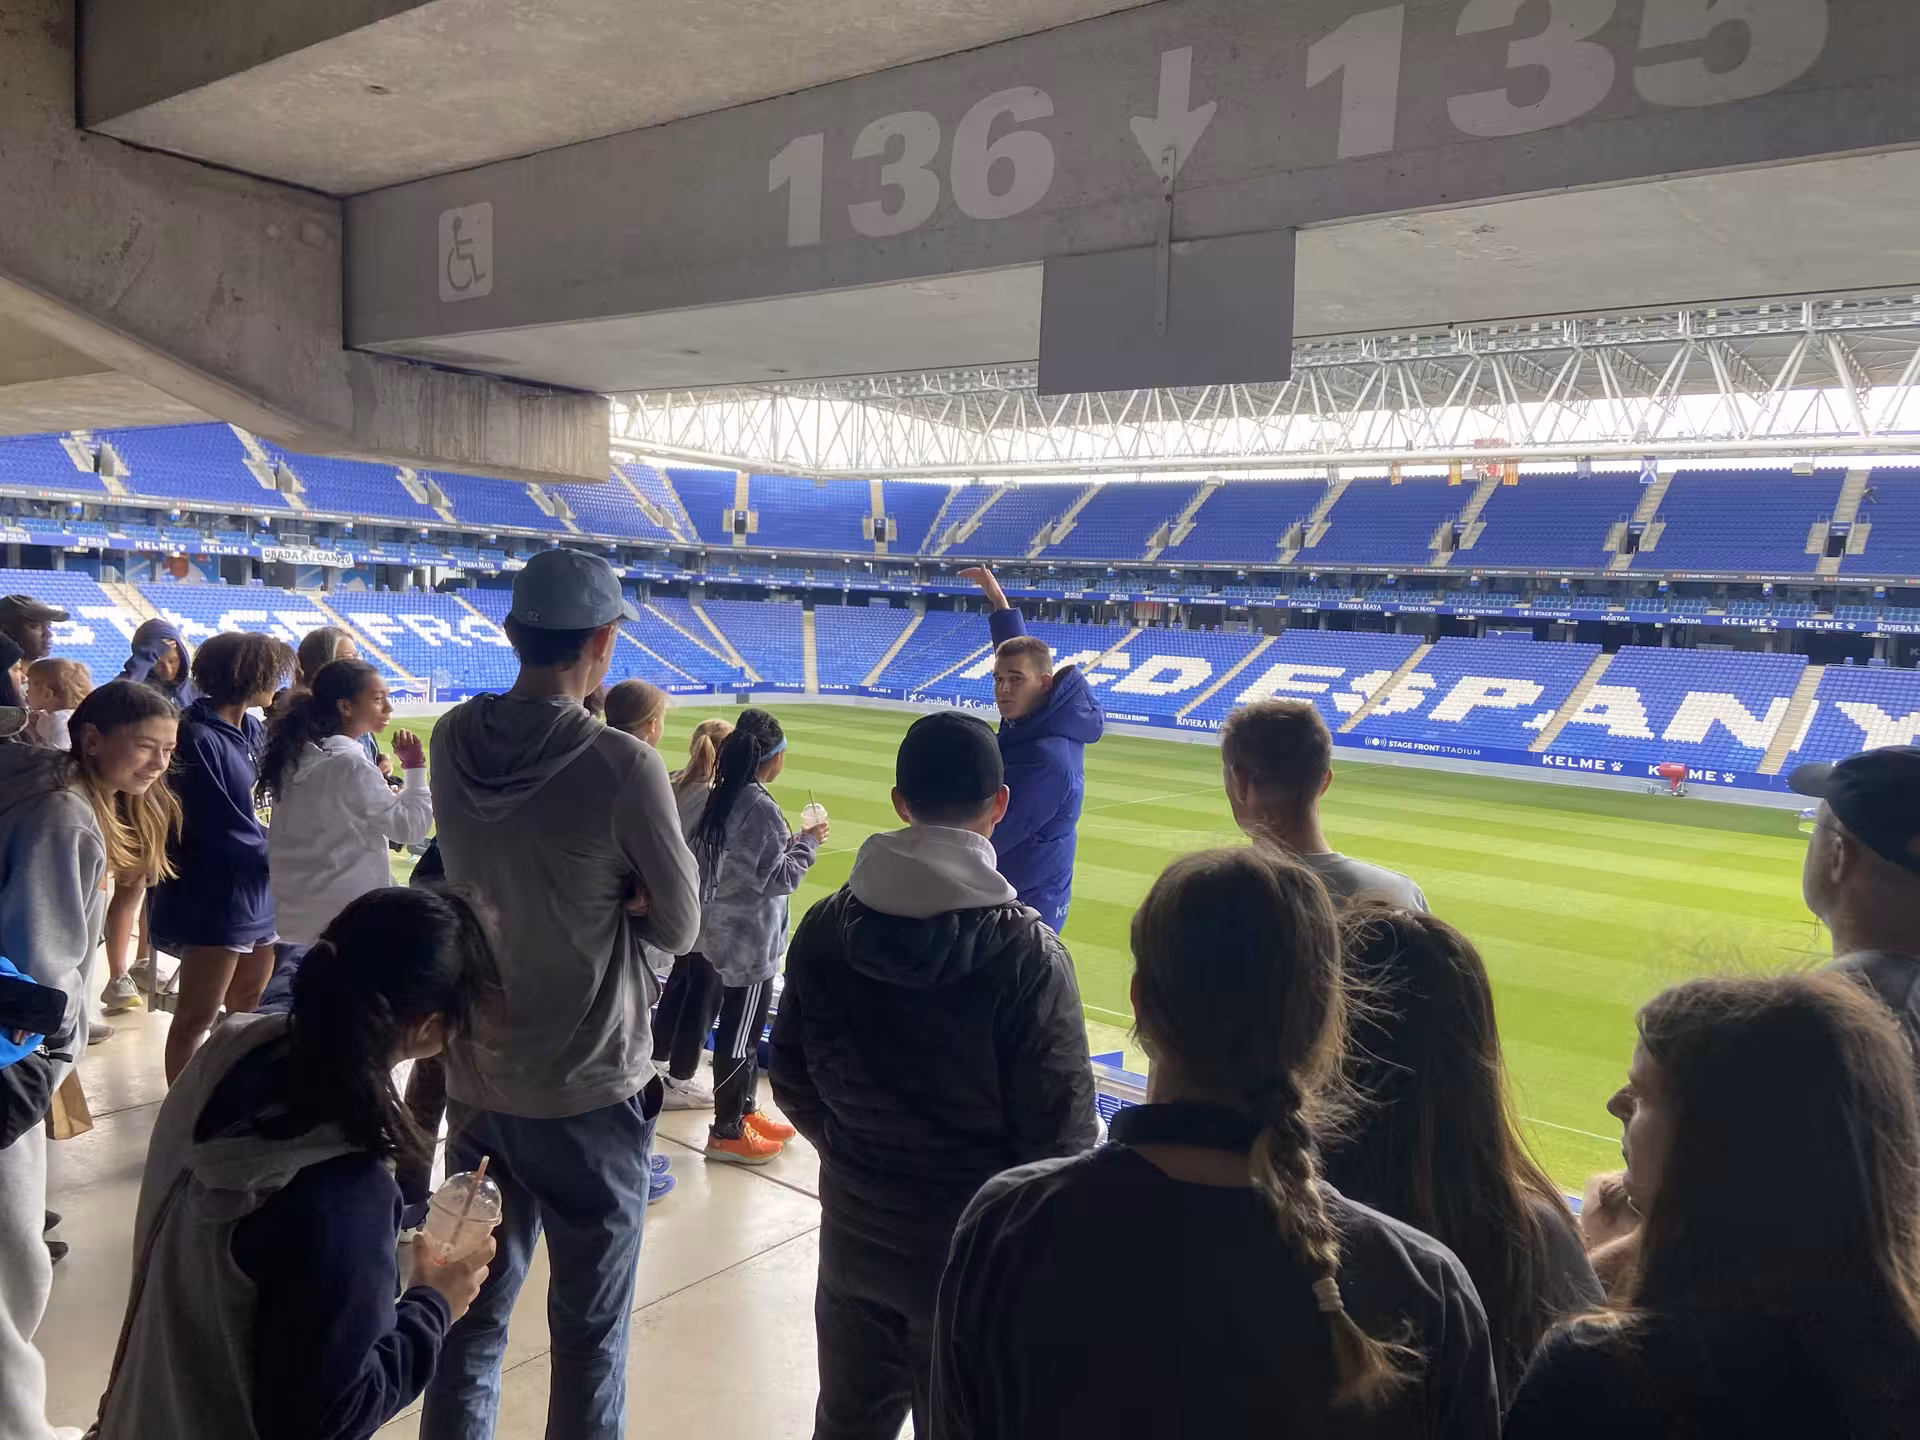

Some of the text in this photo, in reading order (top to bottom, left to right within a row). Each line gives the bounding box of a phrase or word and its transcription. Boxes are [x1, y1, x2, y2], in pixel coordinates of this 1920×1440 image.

[1305, 0, 1832, 160] 135
[767, 86, 1056, 249] 136
[135, 541, 176, 551] KELME
[201, 545, 240, 554] KELME
[457, 560, 478, 568] RIVIERA
[1338, 602, 1382, 611] RIVIERA MAYA
[1722, 617, 1767, 626] KELME
[1796, 620, 1844, 629] KELME
[1876, 622, 1912, 632] RIVIERA
[919, 694, 953, 707] CaixaBank
[973, 700, 1000, 711] CaixaB
[1106, 712, 1131, 721] ESTRELLA
[1176, 716, 1208, 729] RIVIERA
[1388, 740, 1480, 756] STAGE FRONT STADIUM
[1542, 755, 1606, 771] KELME
[1648, 765, 1717, 781] KME
